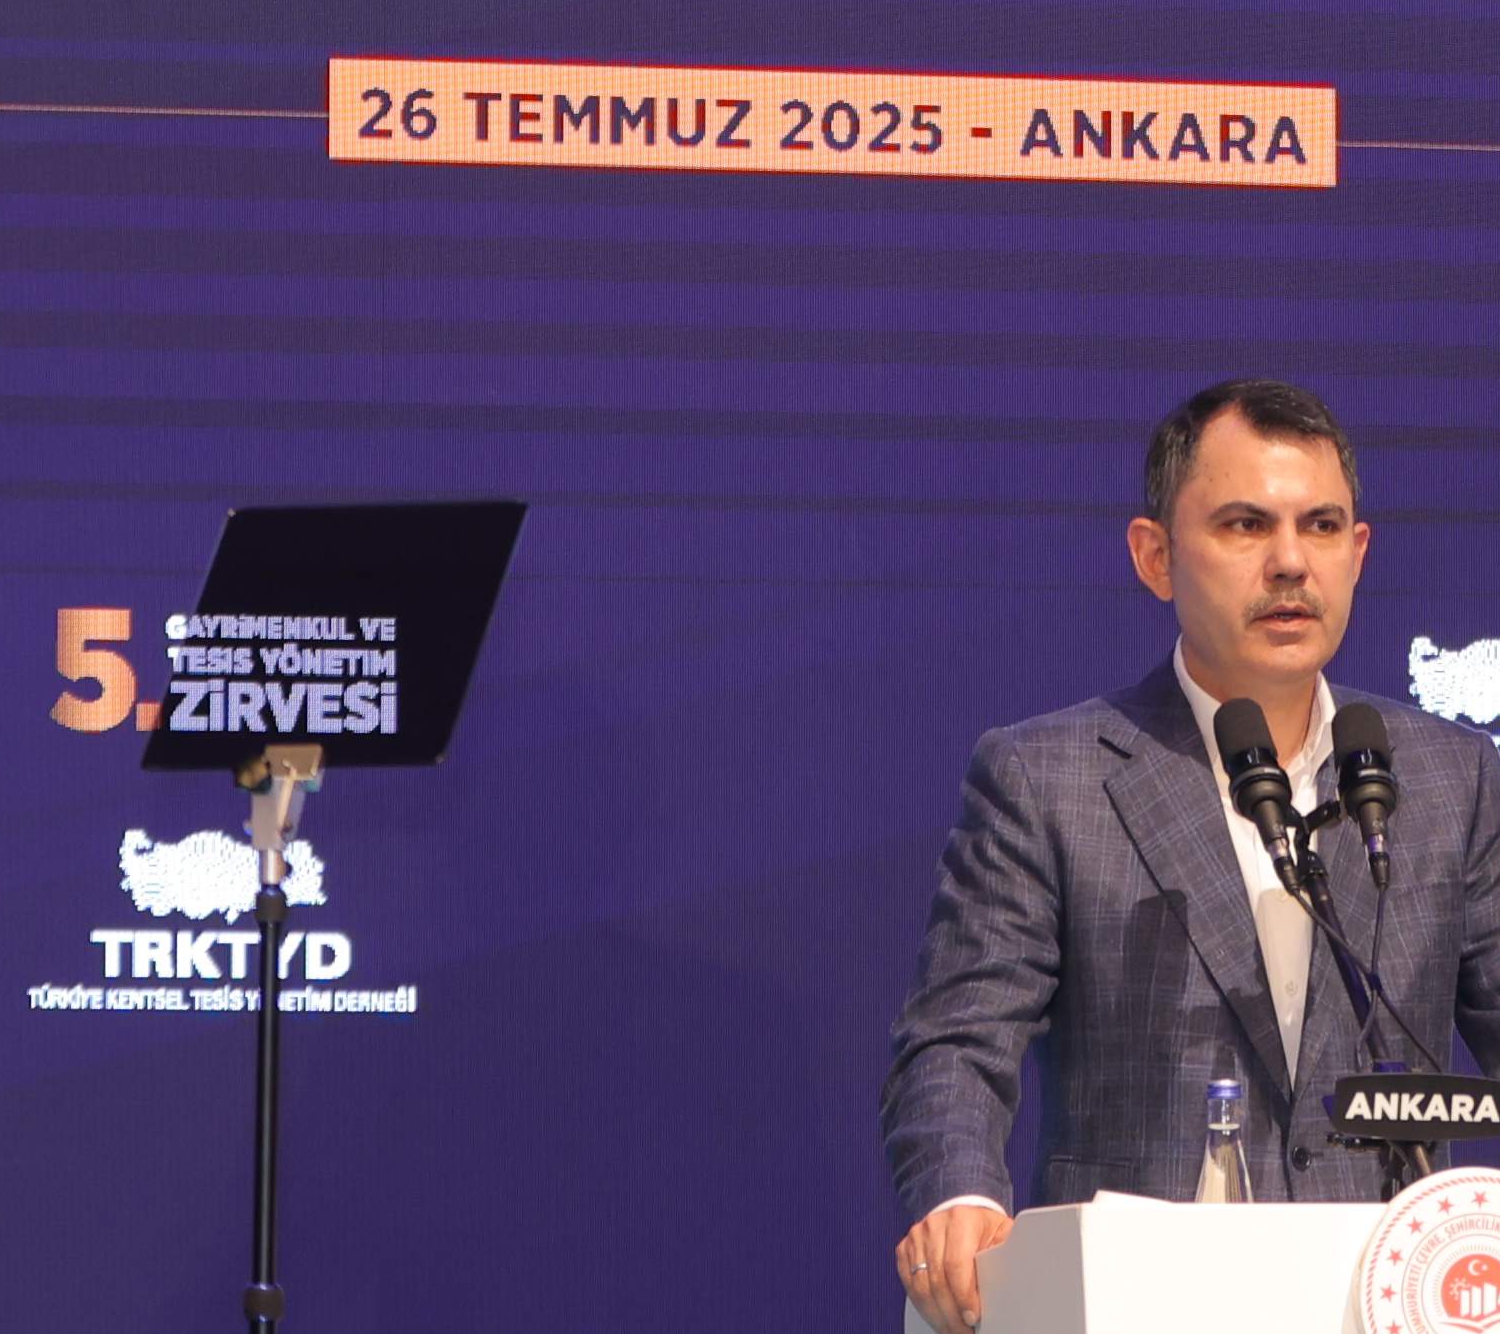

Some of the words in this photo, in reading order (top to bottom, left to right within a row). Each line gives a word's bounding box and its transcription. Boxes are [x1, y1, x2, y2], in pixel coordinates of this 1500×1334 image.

[359, 88, 437, 141] 26
[463, 92, 752, 149] TEMMUZ
[780, 99, 942, 154] 2025
[1020, 109, 1306, 165] ANKARA
[361, 620, 395, 641] VE
[52, 606, 162, 733] 5.
[1345, 1091, 1500, 1123] ANKARA
